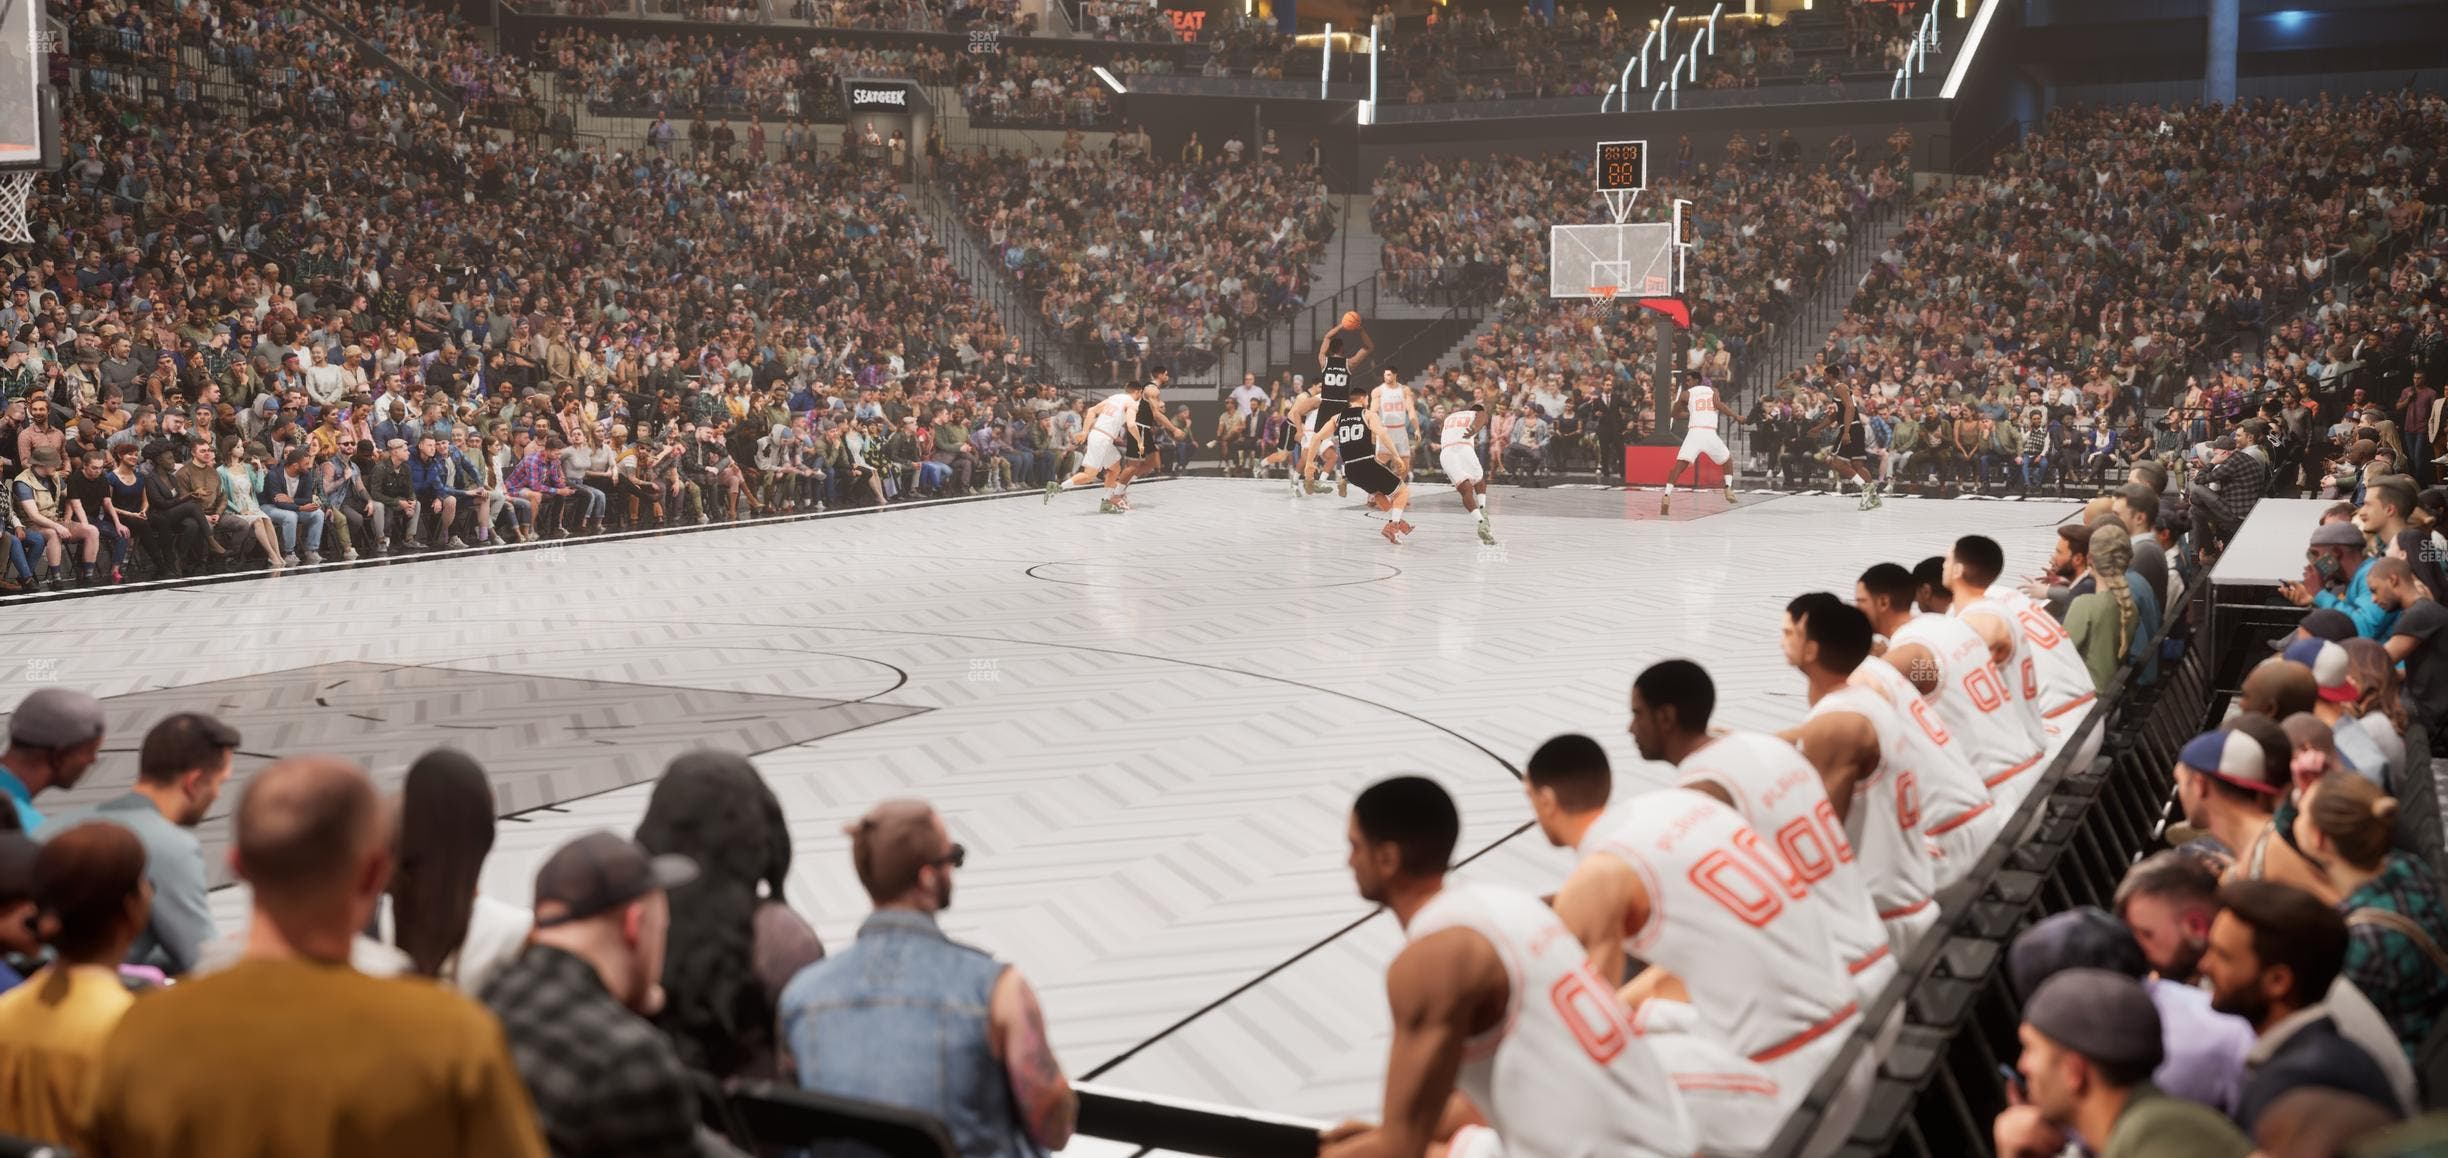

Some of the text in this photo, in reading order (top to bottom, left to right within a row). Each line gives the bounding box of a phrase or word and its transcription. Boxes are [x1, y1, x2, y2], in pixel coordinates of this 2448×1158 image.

[853, 88, 906, 106] SEATGEEK
[1324, 373, 1348, 387] 00
[1339, 423, 1364, 444] 00
